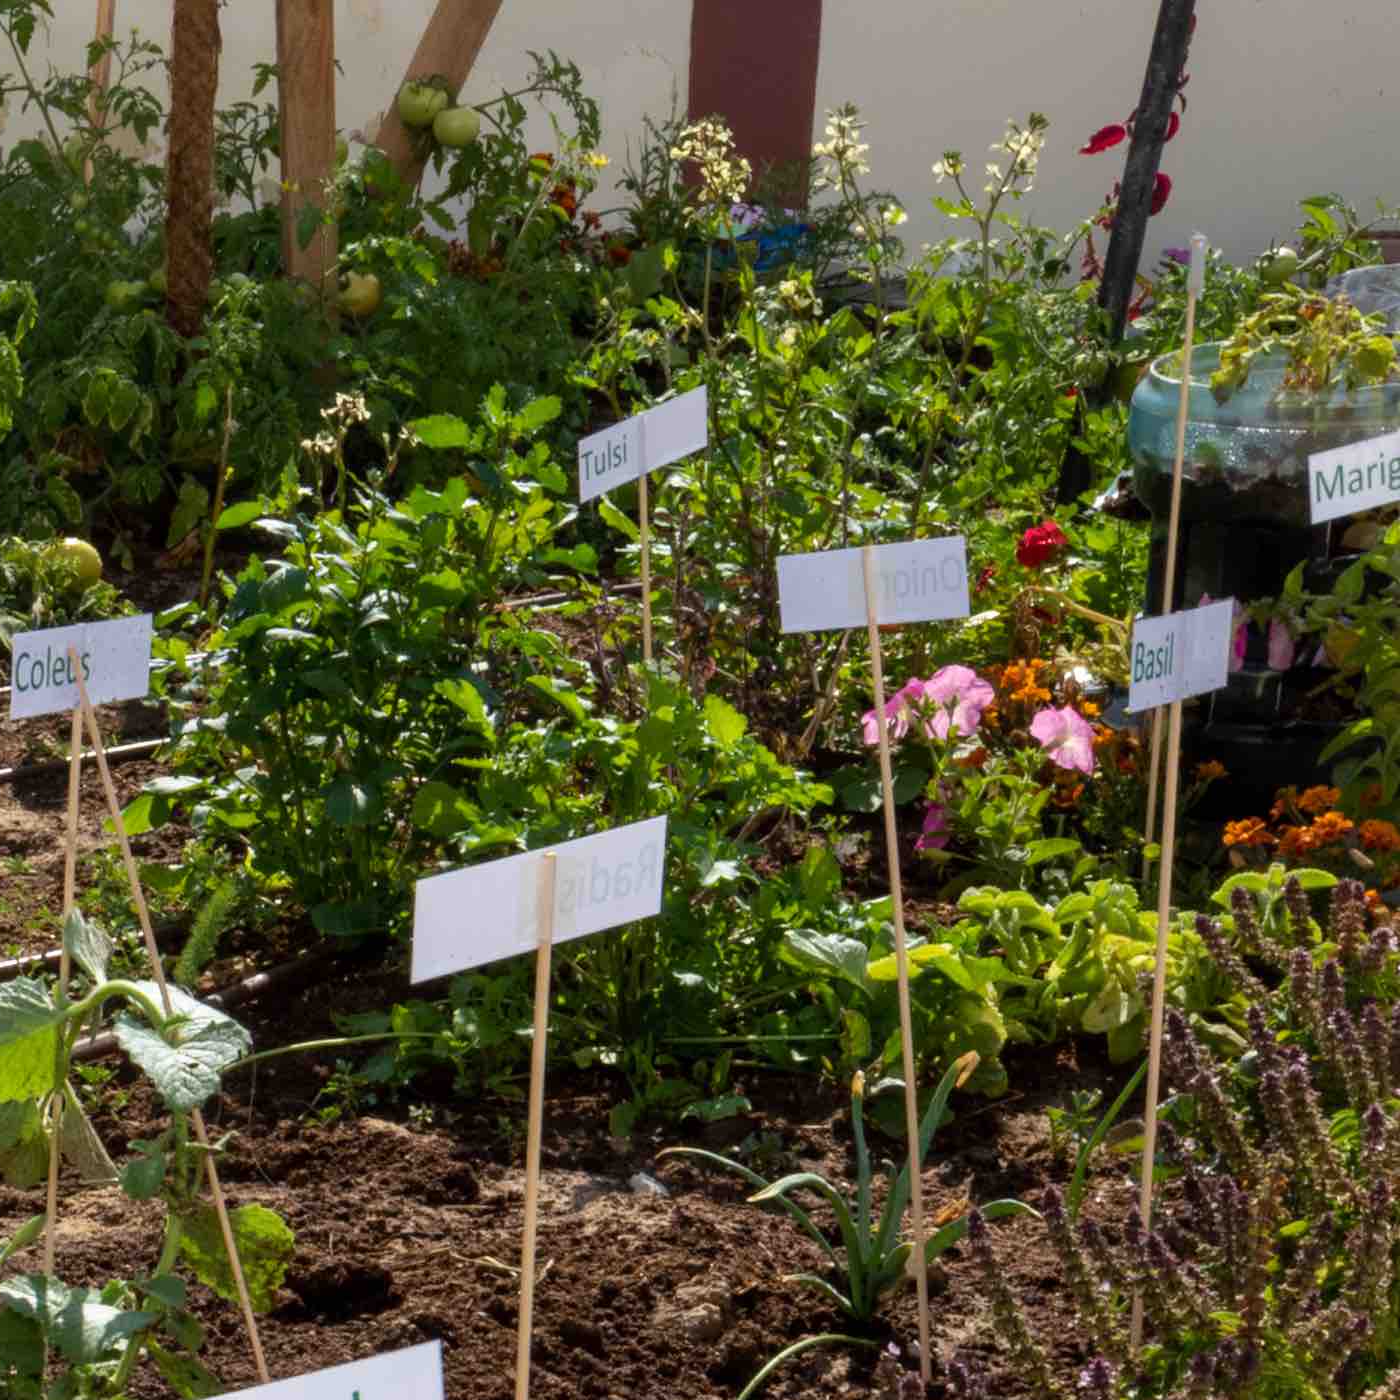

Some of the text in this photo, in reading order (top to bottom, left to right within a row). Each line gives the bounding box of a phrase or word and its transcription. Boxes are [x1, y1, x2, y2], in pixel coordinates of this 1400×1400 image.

[581, 433, 628, 481] Tulsi
[1315, 451, 1400, 503] Marig
[1133, 631, 1175, 683] Basil
